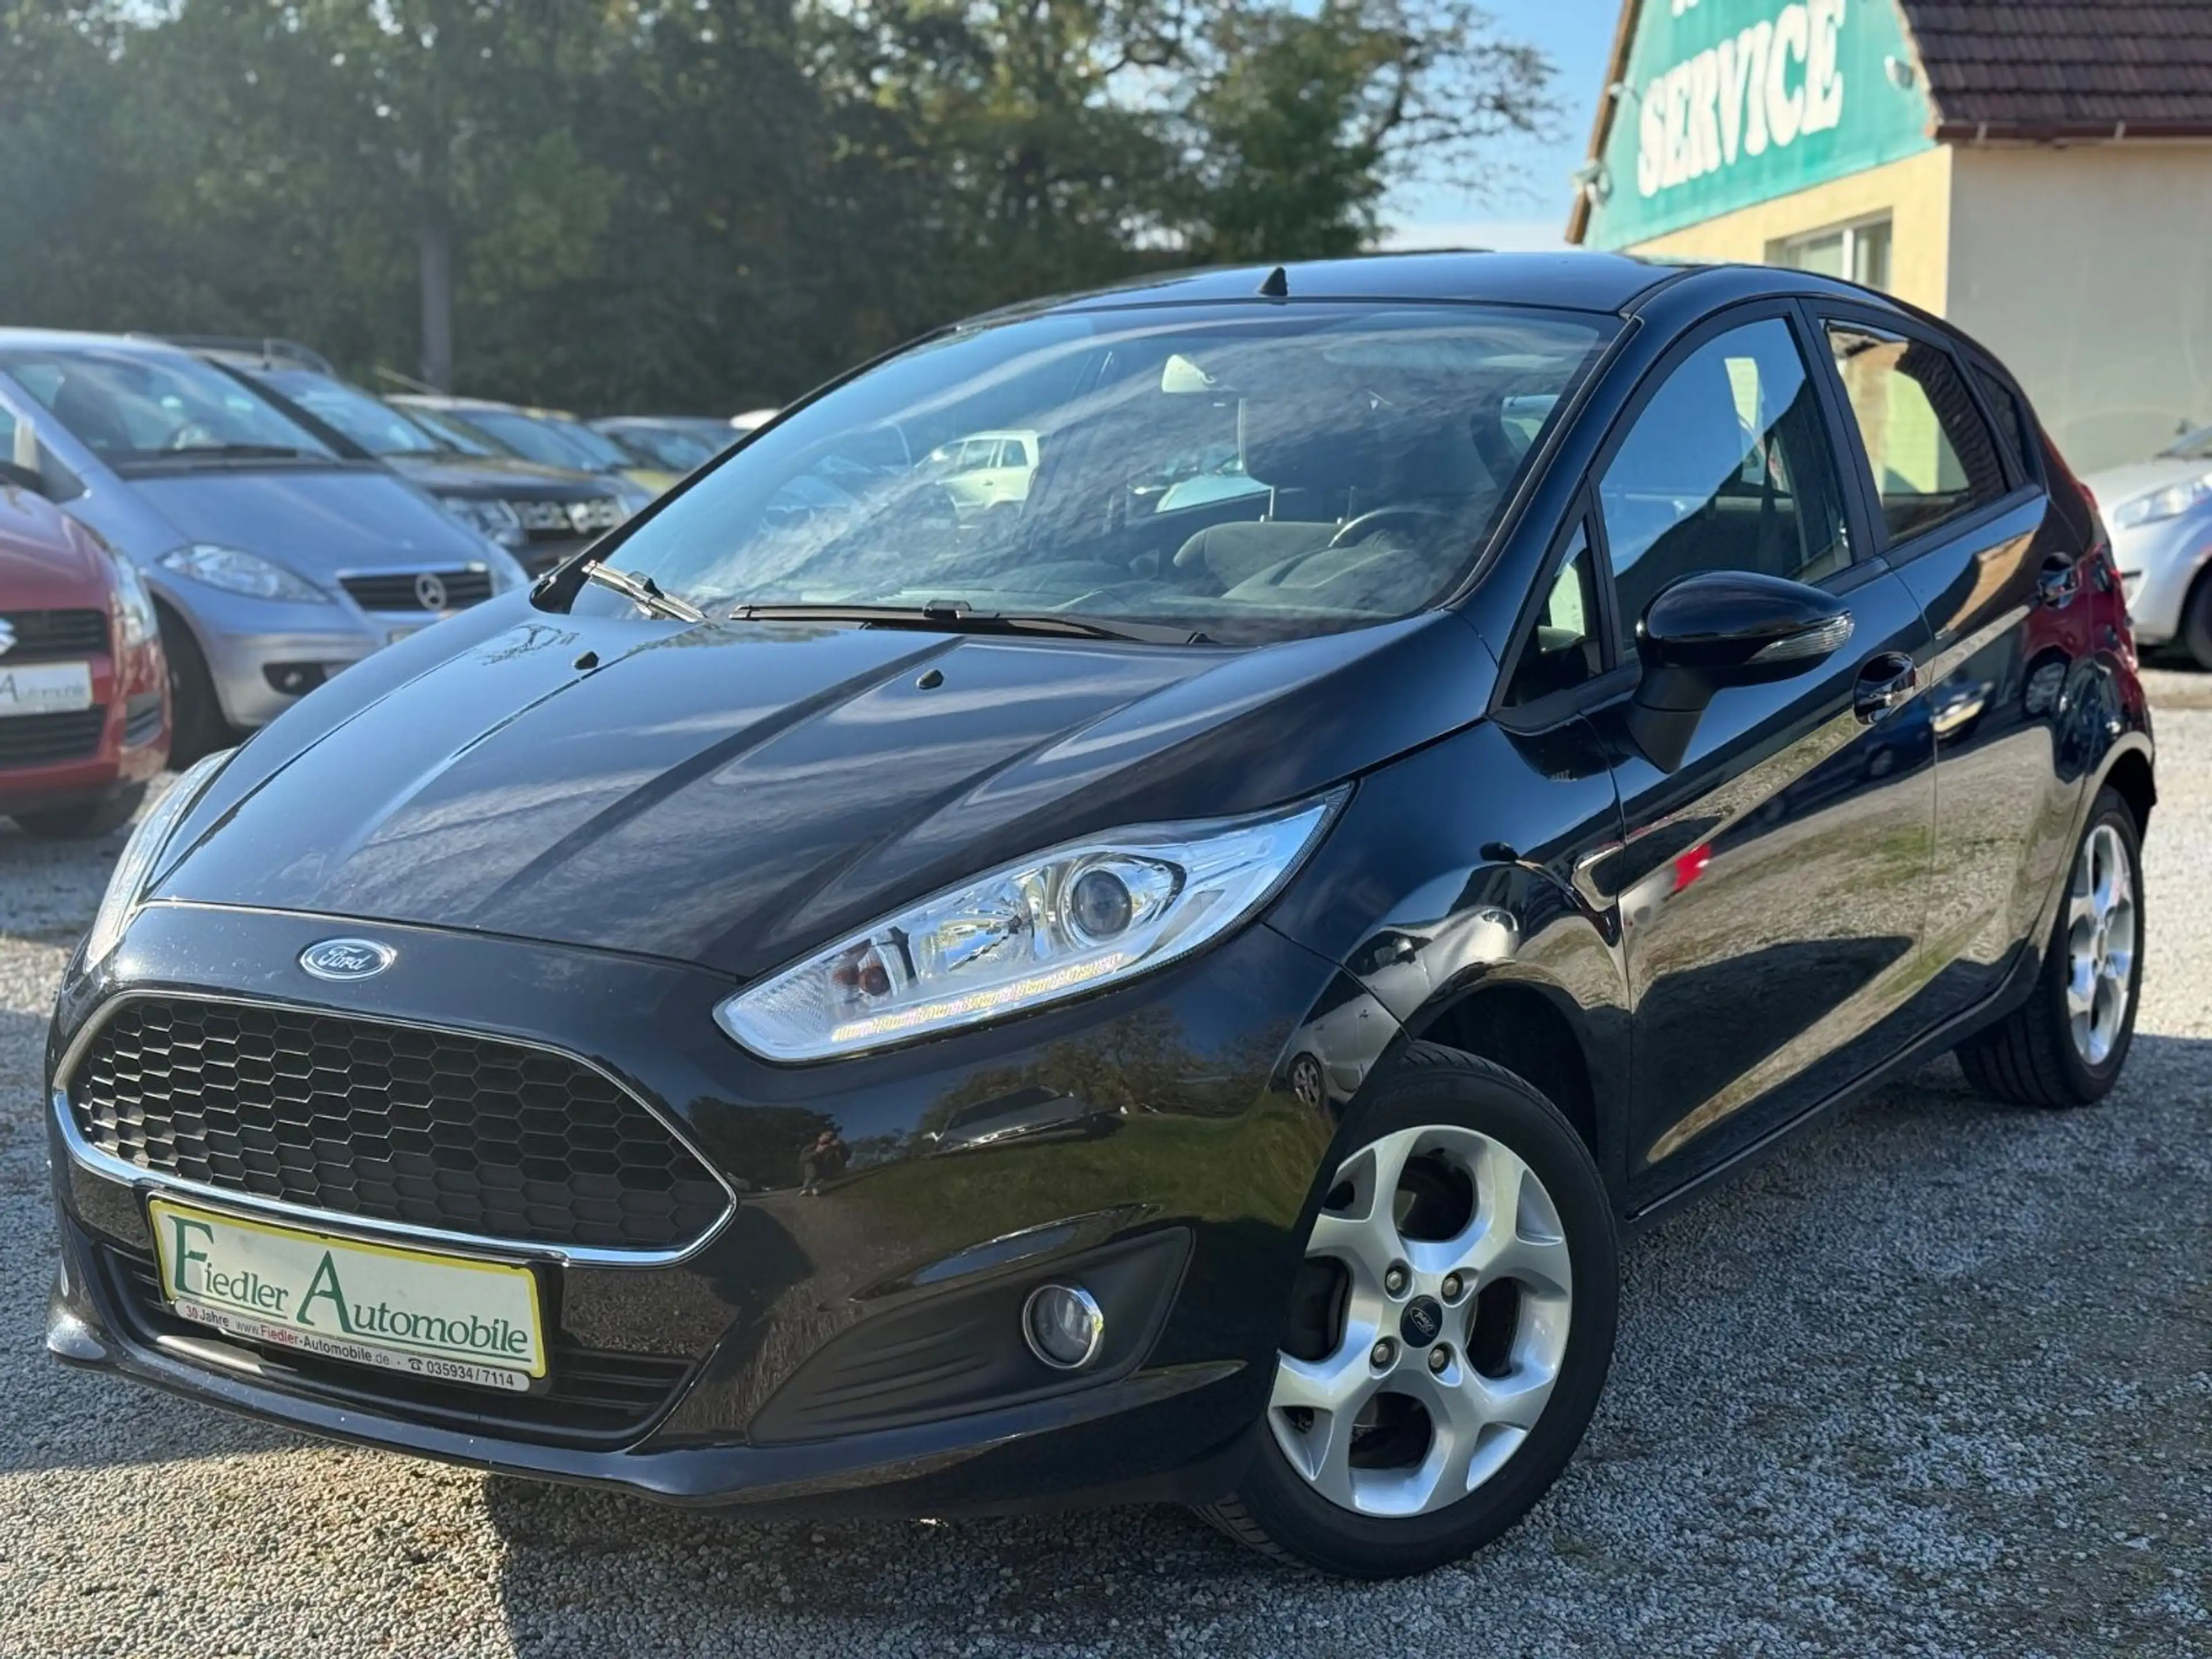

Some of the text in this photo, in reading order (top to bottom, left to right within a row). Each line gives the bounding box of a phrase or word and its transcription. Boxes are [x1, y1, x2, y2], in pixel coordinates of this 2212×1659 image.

[1638, 0, 1844, 198] SERVICE
[317, 945, 373, 971] Ford
[168, 1214, 528, 1354] Fiedler Automobile
[185, 1304, 199, 1318] 30
[199, 1309, 229, 1327] Jahre
